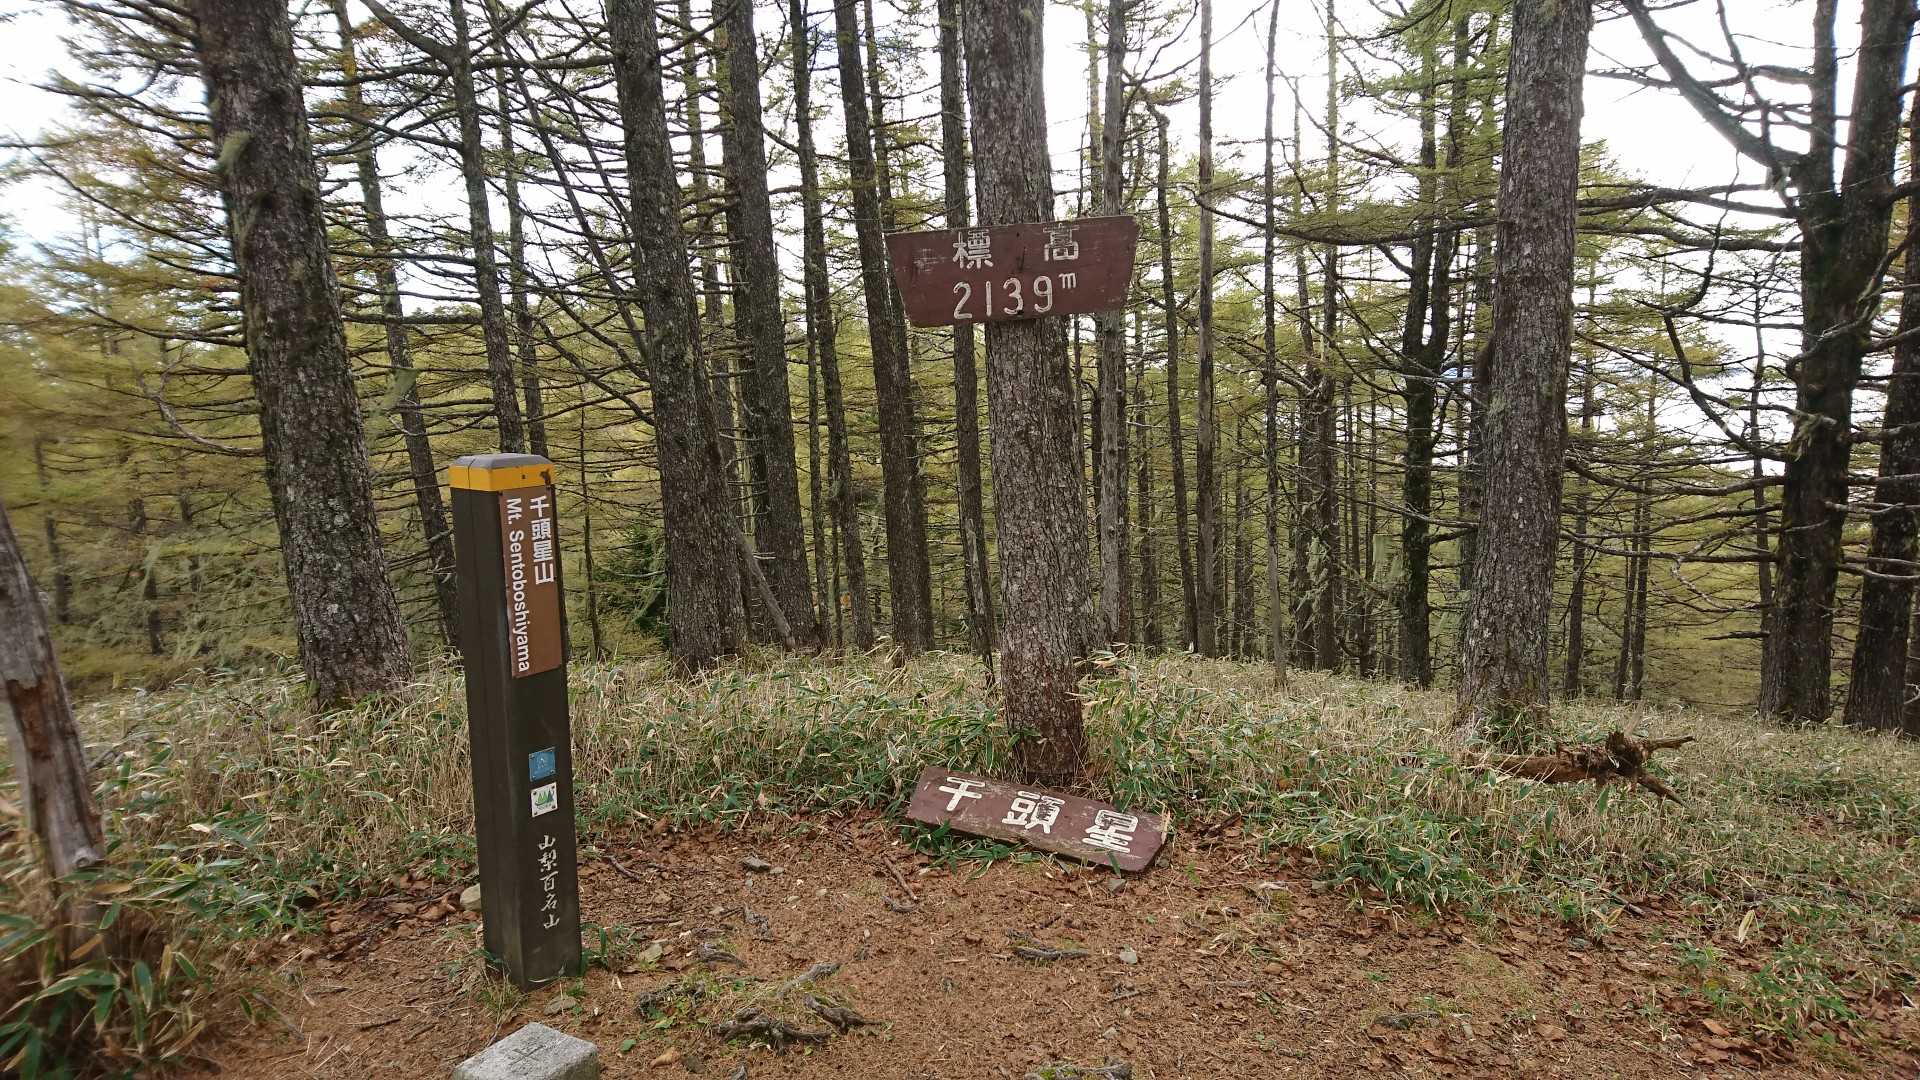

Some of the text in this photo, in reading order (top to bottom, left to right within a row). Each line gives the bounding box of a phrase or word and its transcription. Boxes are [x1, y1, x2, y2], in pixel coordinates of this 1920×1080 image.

[506, 497, 531, 673] Mt. Sentoboshiyama
[529, 495, 555, 585] 千頭星山
[938, 776, 1139, 854] 千頭星
[537, 834, 561, 930] 山梨百名山
